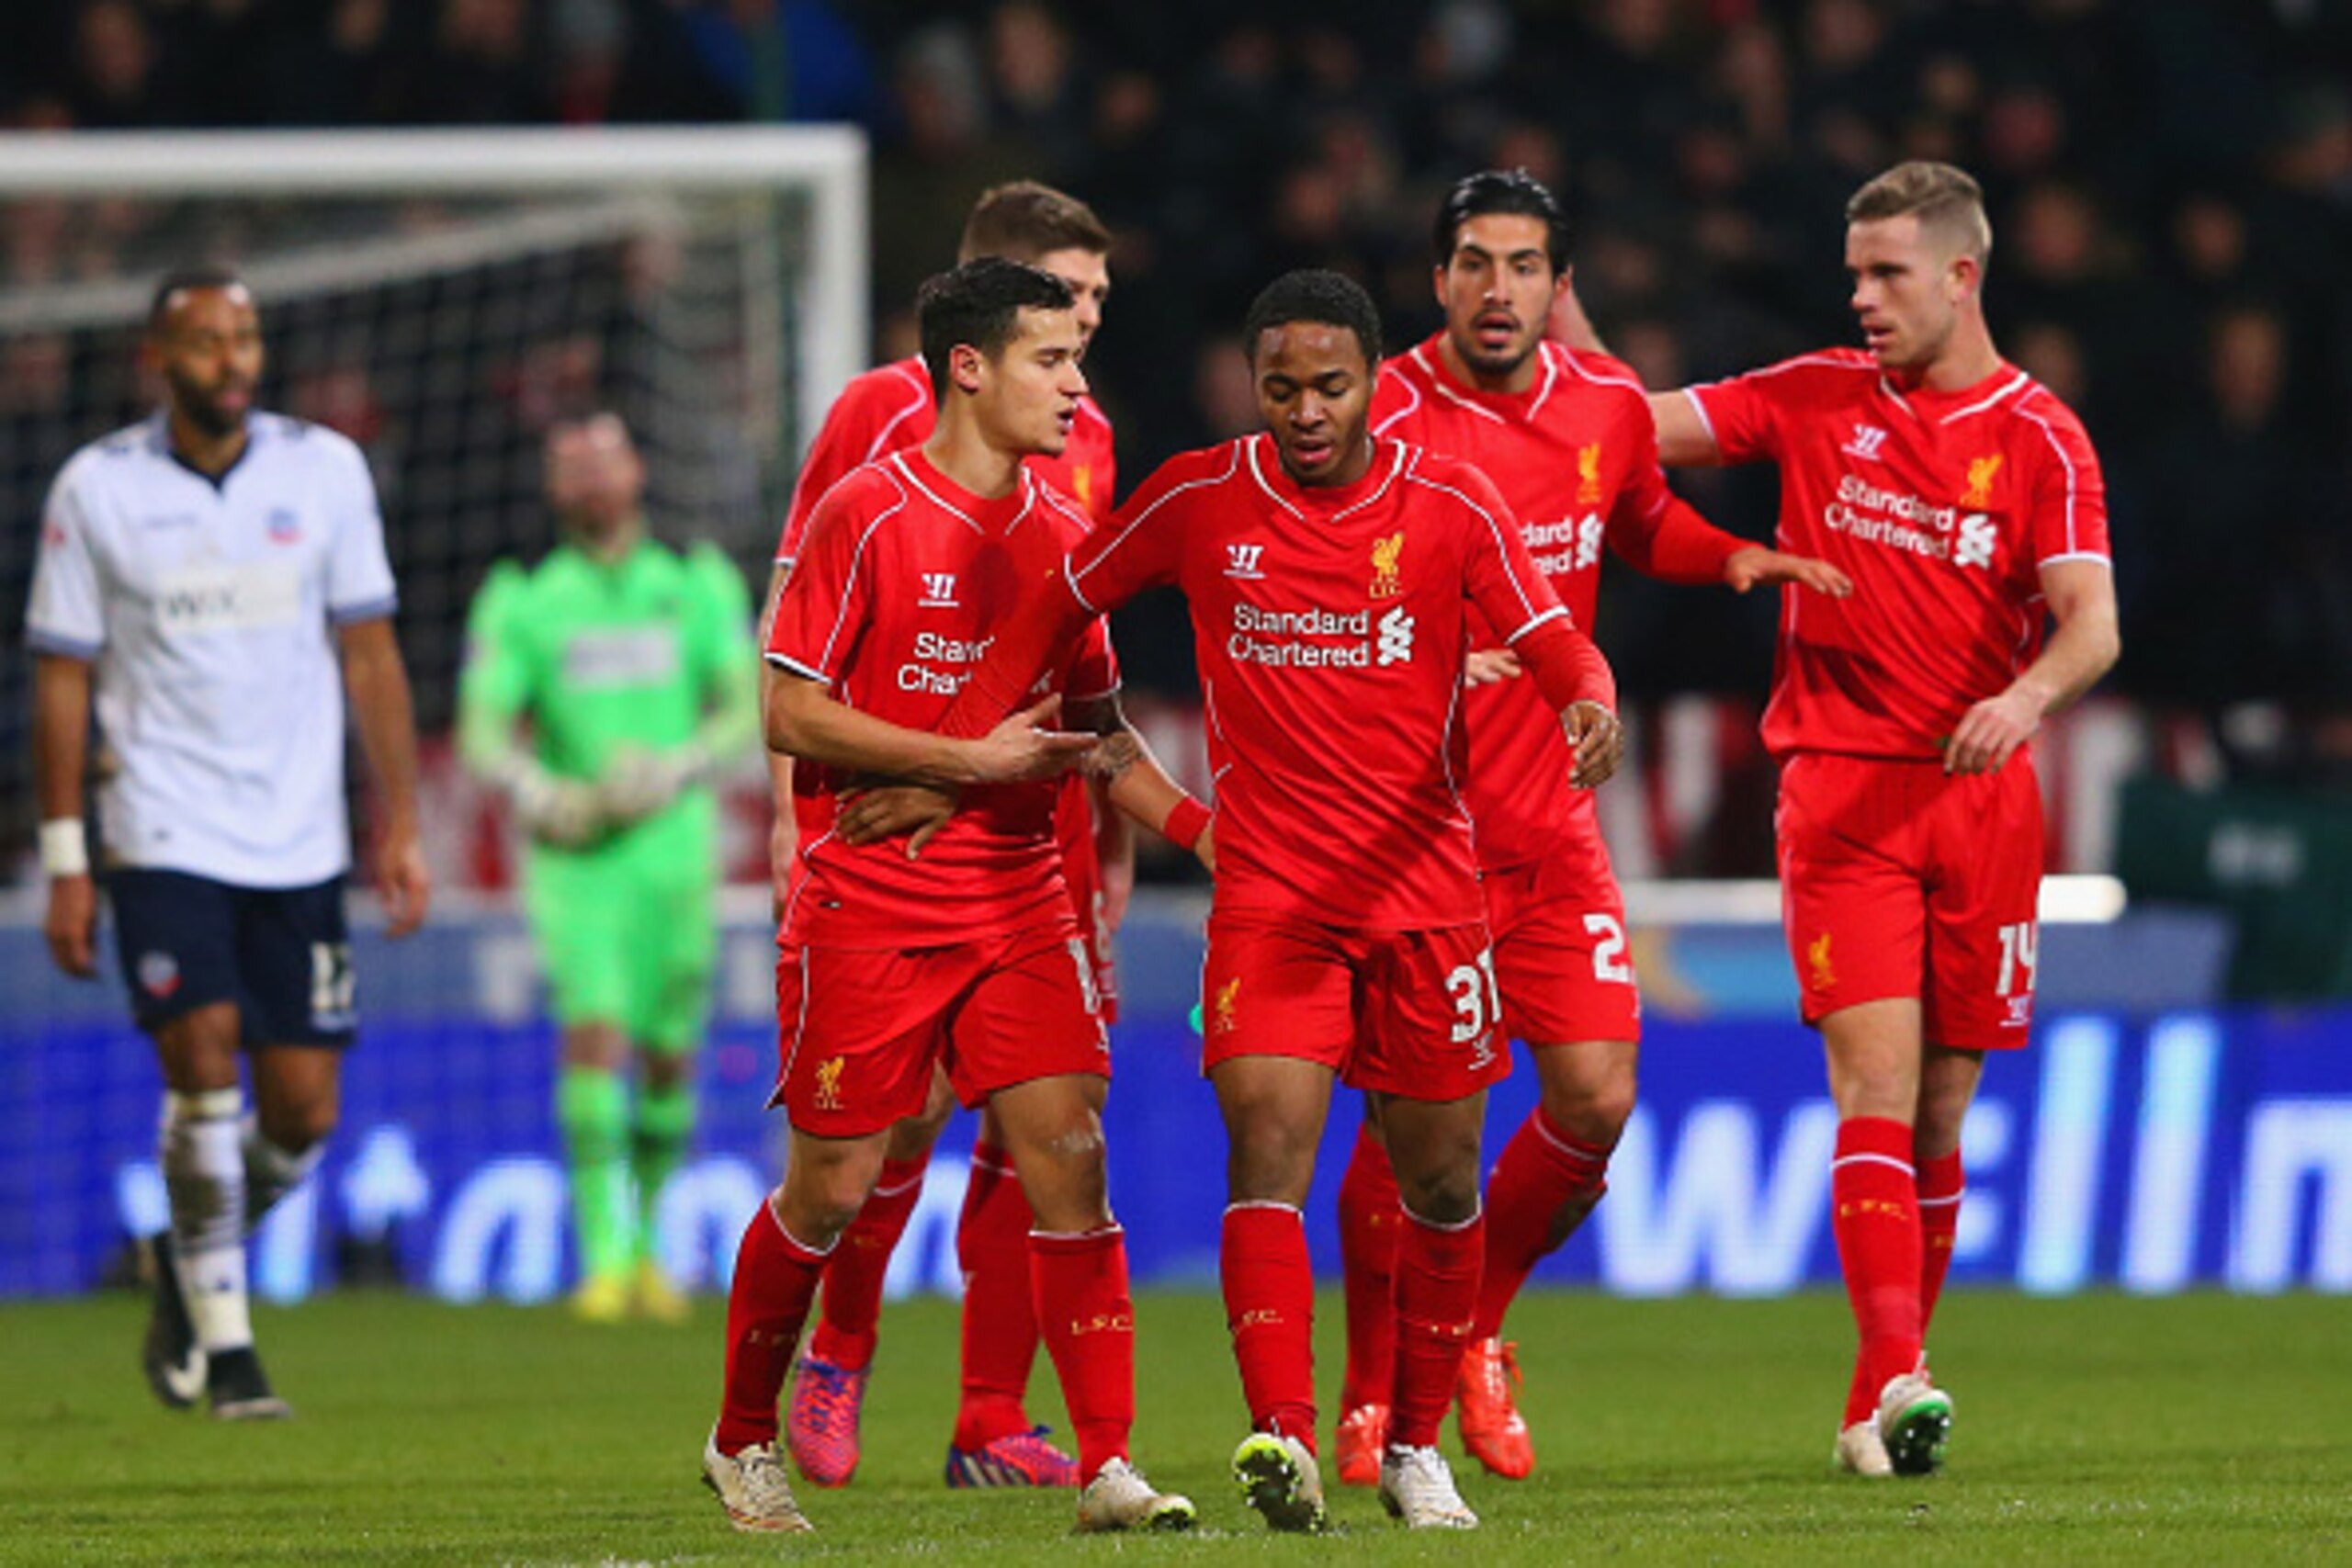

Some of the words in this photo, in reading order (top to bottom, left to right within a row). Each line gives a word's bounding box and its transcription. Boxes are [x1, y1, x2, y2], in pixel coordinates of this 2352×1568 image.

[1824, 502, 1949, 559] Chartered
[1837, 474, 1955, 532] Standard
[1234, 602, 1370, 635] Standard
[1227, 633, 1370, 667] Chartered
[1996, 921, 2038, 996] 14
[1445, 947, 1502, 1043] 31
